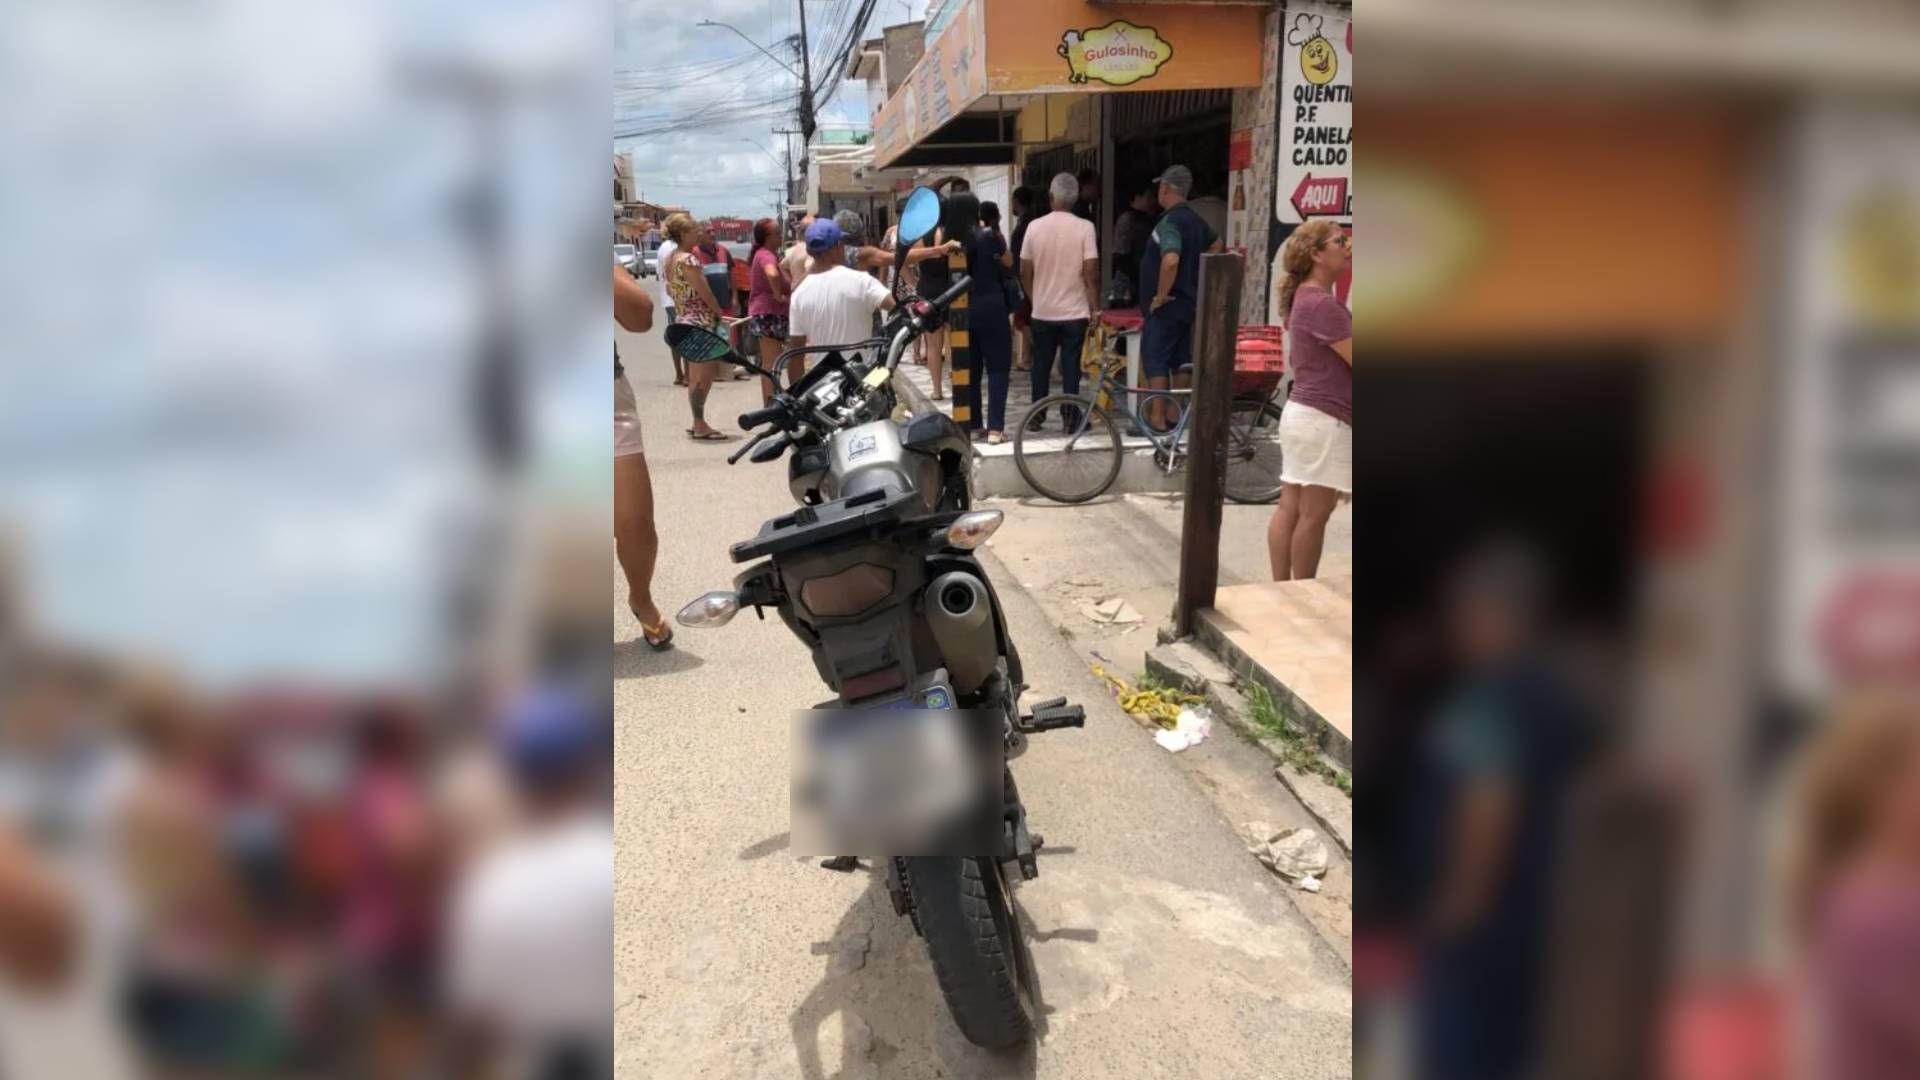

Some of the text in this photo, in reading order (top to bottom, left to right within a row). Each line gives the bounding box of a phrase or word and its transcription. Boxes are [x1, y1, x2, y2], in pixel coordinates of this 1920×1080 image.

[1085, 43, 1158, 61] Gulosinho
[1294, 84, 1352, 104] QUENTI
[1292, 147, 1347, 166] CALDO
[1301, 185, 1338, 209] AQUI
